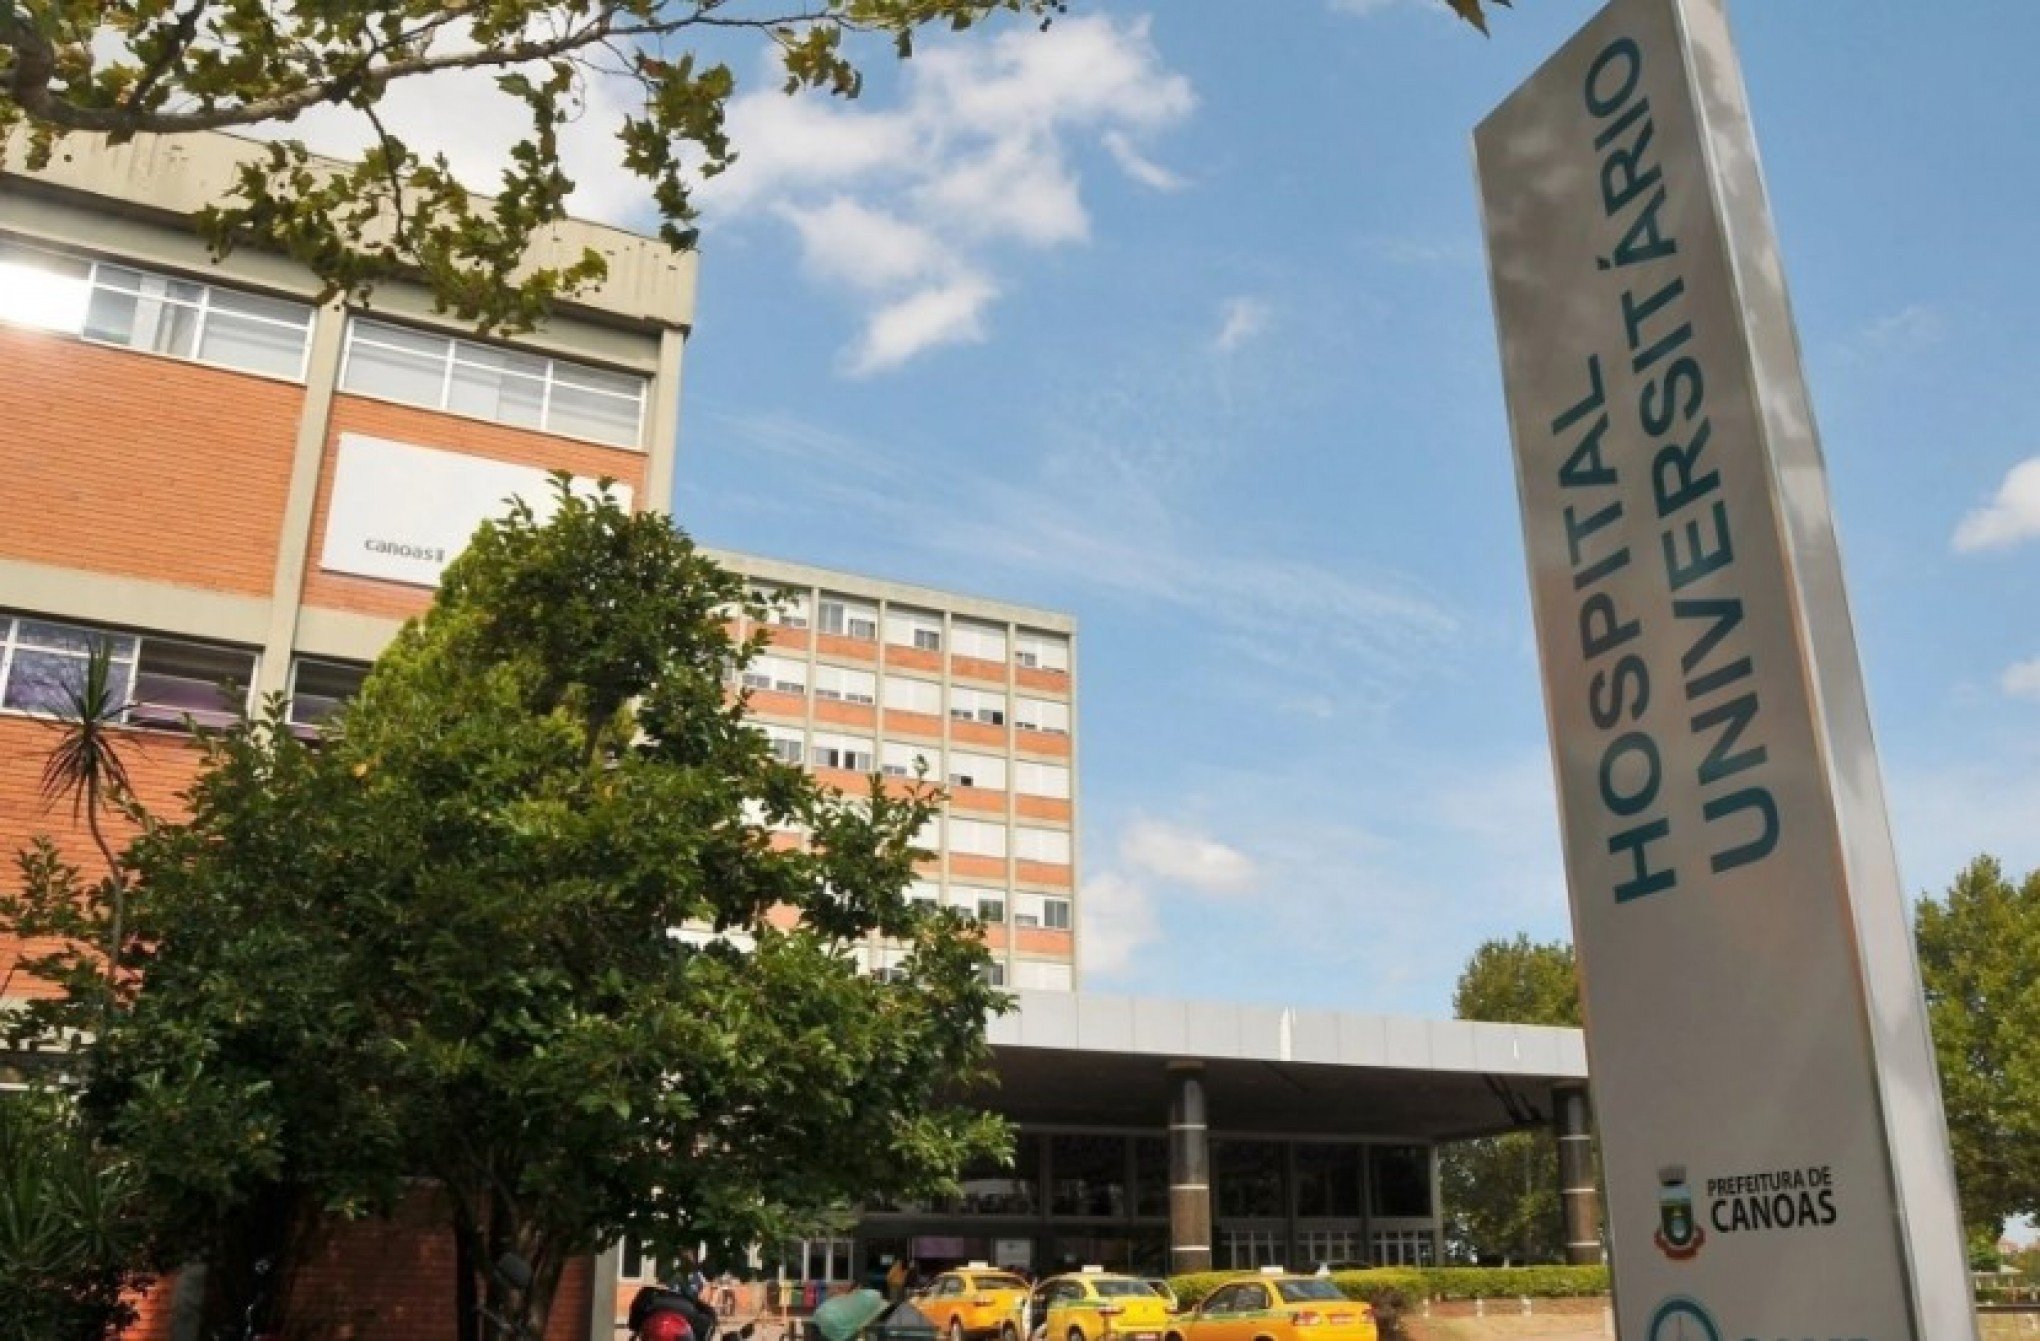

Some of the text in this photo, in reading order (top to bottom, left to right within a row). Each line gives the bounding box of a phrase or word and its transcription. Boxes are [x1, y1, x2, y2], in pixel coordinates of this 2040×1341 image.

[1585, 37, 1780, 874] UNIVERSITÁRIO
[1553, 353, 1677, 904] HOSPITAL
[1708, 1166, 1832, 1197] PREFEITURA DE
[1711, 1189, 1837, 1233] CANOAS
